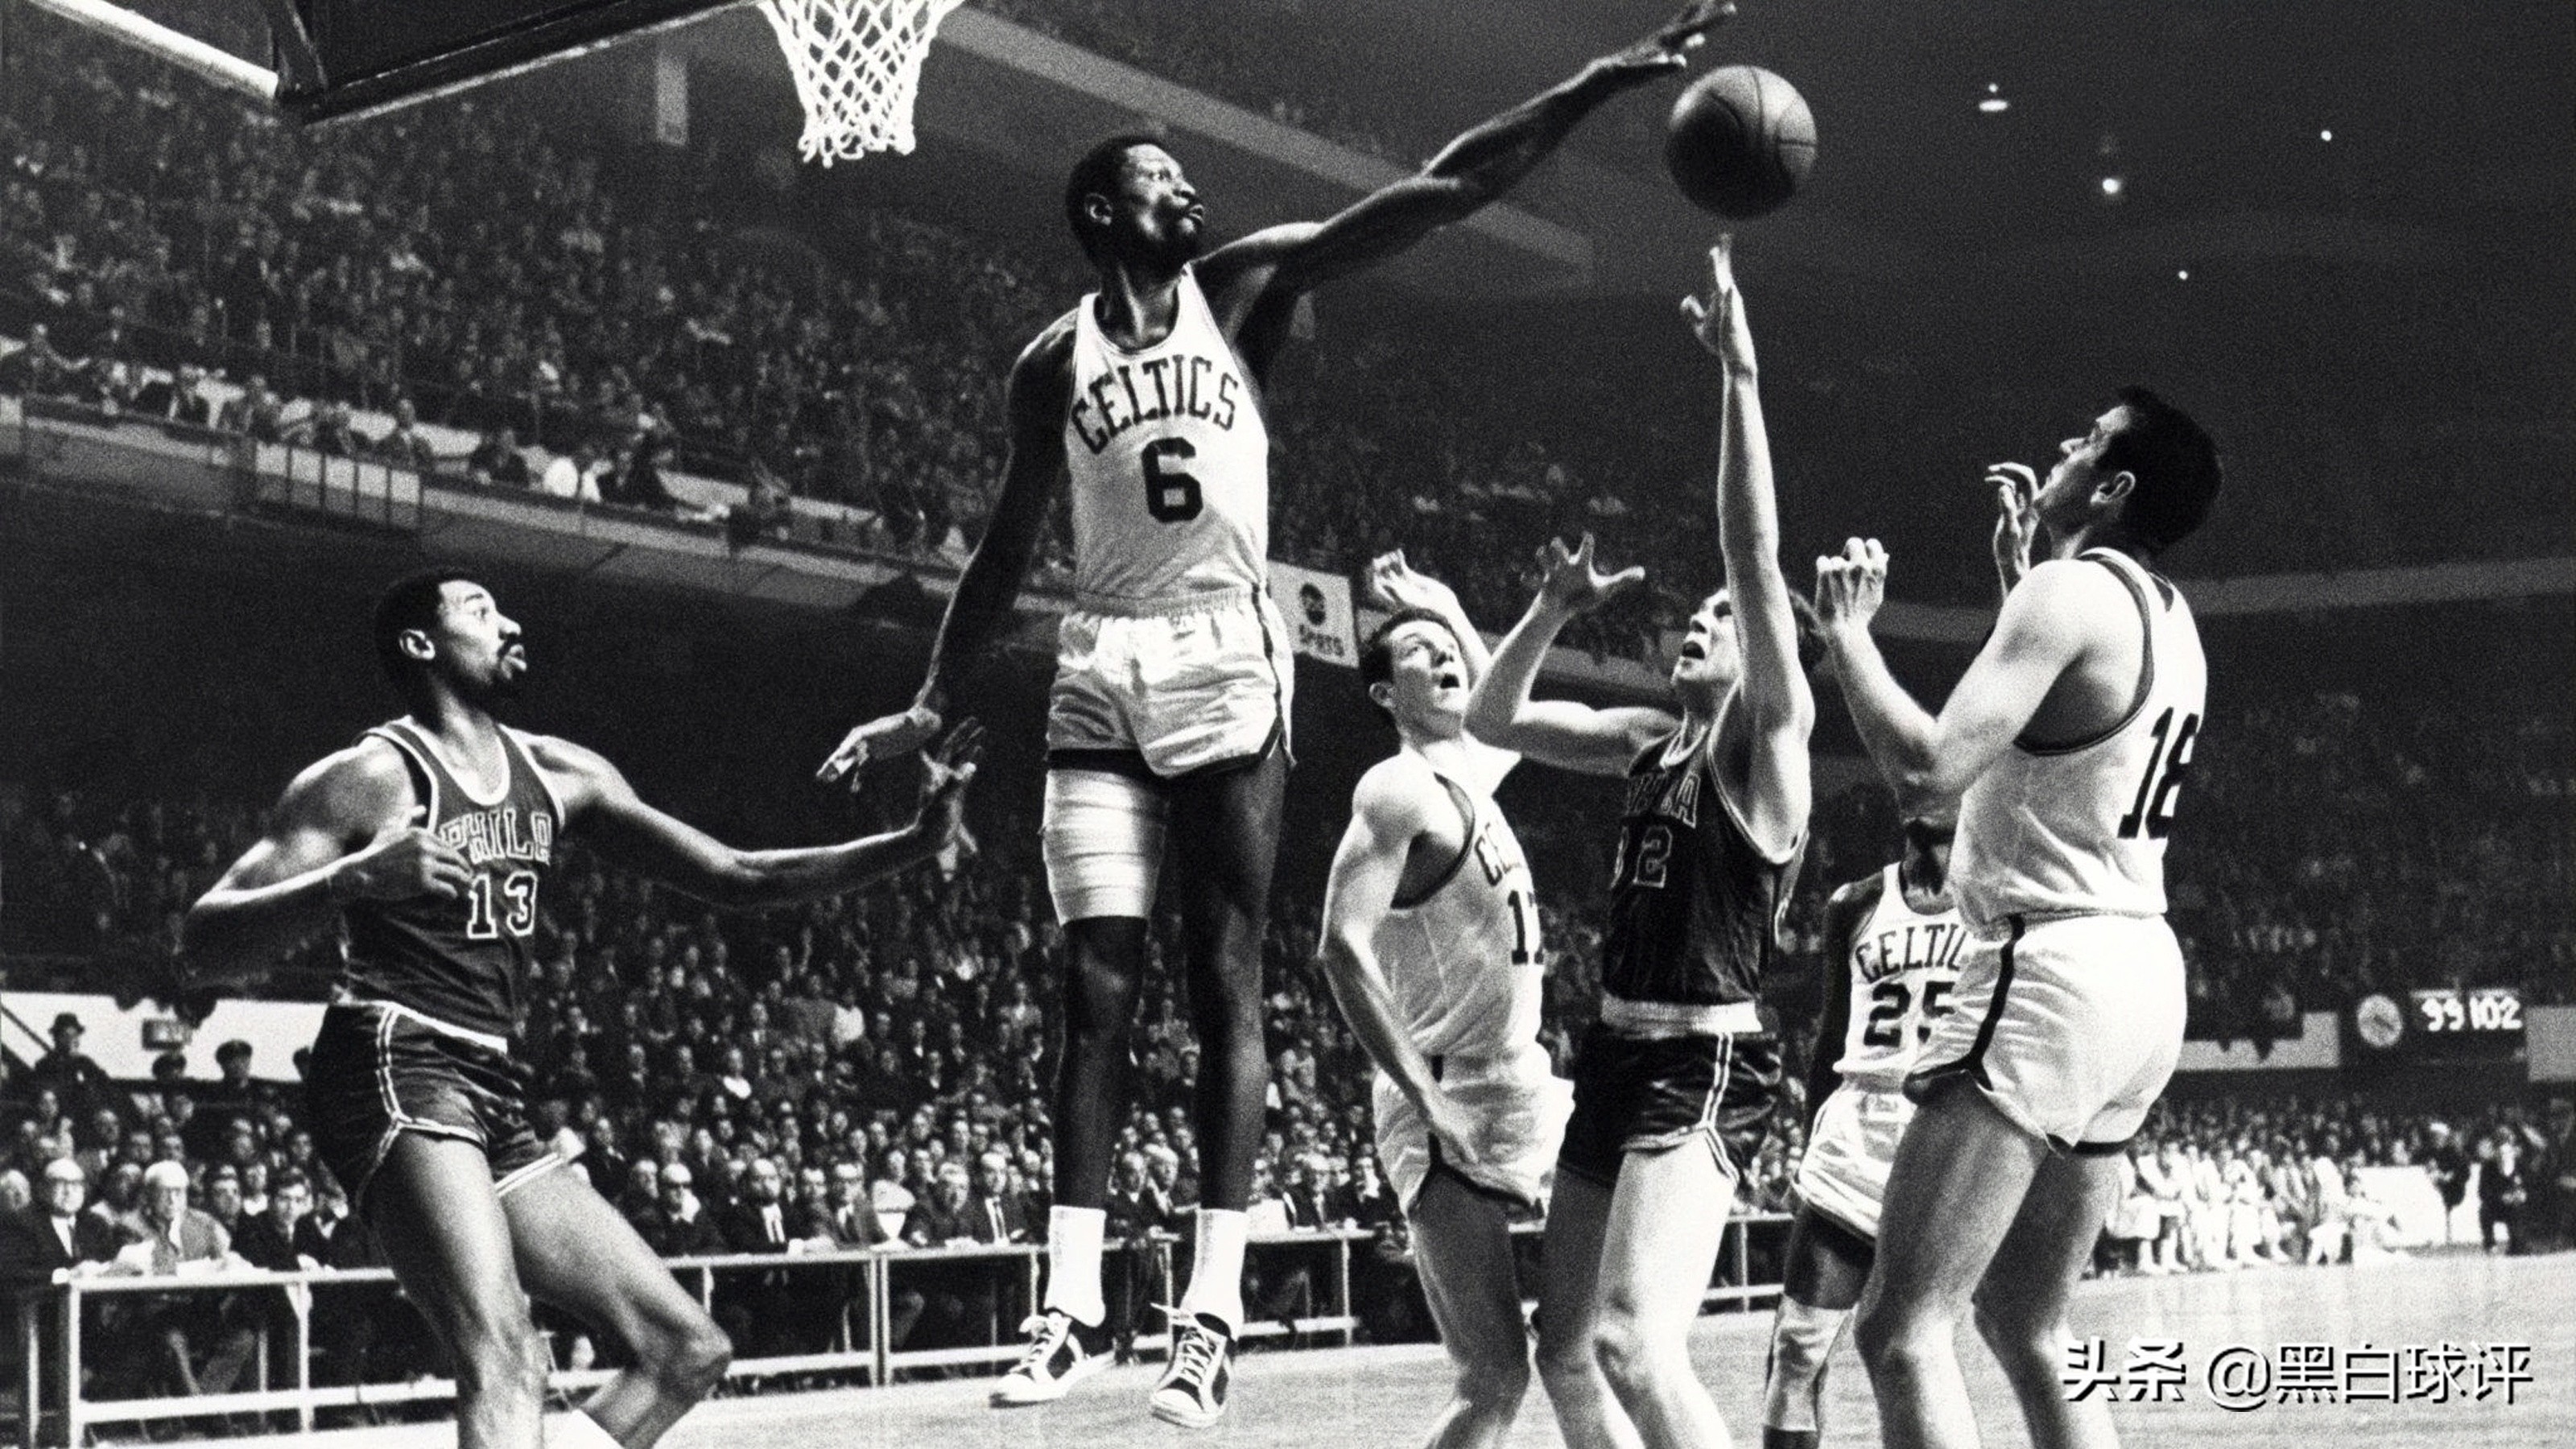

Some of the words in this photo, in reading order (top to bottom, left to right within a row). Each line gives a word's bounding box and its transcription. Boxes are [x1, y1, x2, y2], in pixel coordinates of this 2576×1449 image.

[1071, 354, 1239, 454] CELTICS
[1141, 436, 1203, 522] 6
[466, 870, 539, 939] 13
[1864, 981, 1956, 1046] 25
[2469, 995, 2523, 1030] 102
